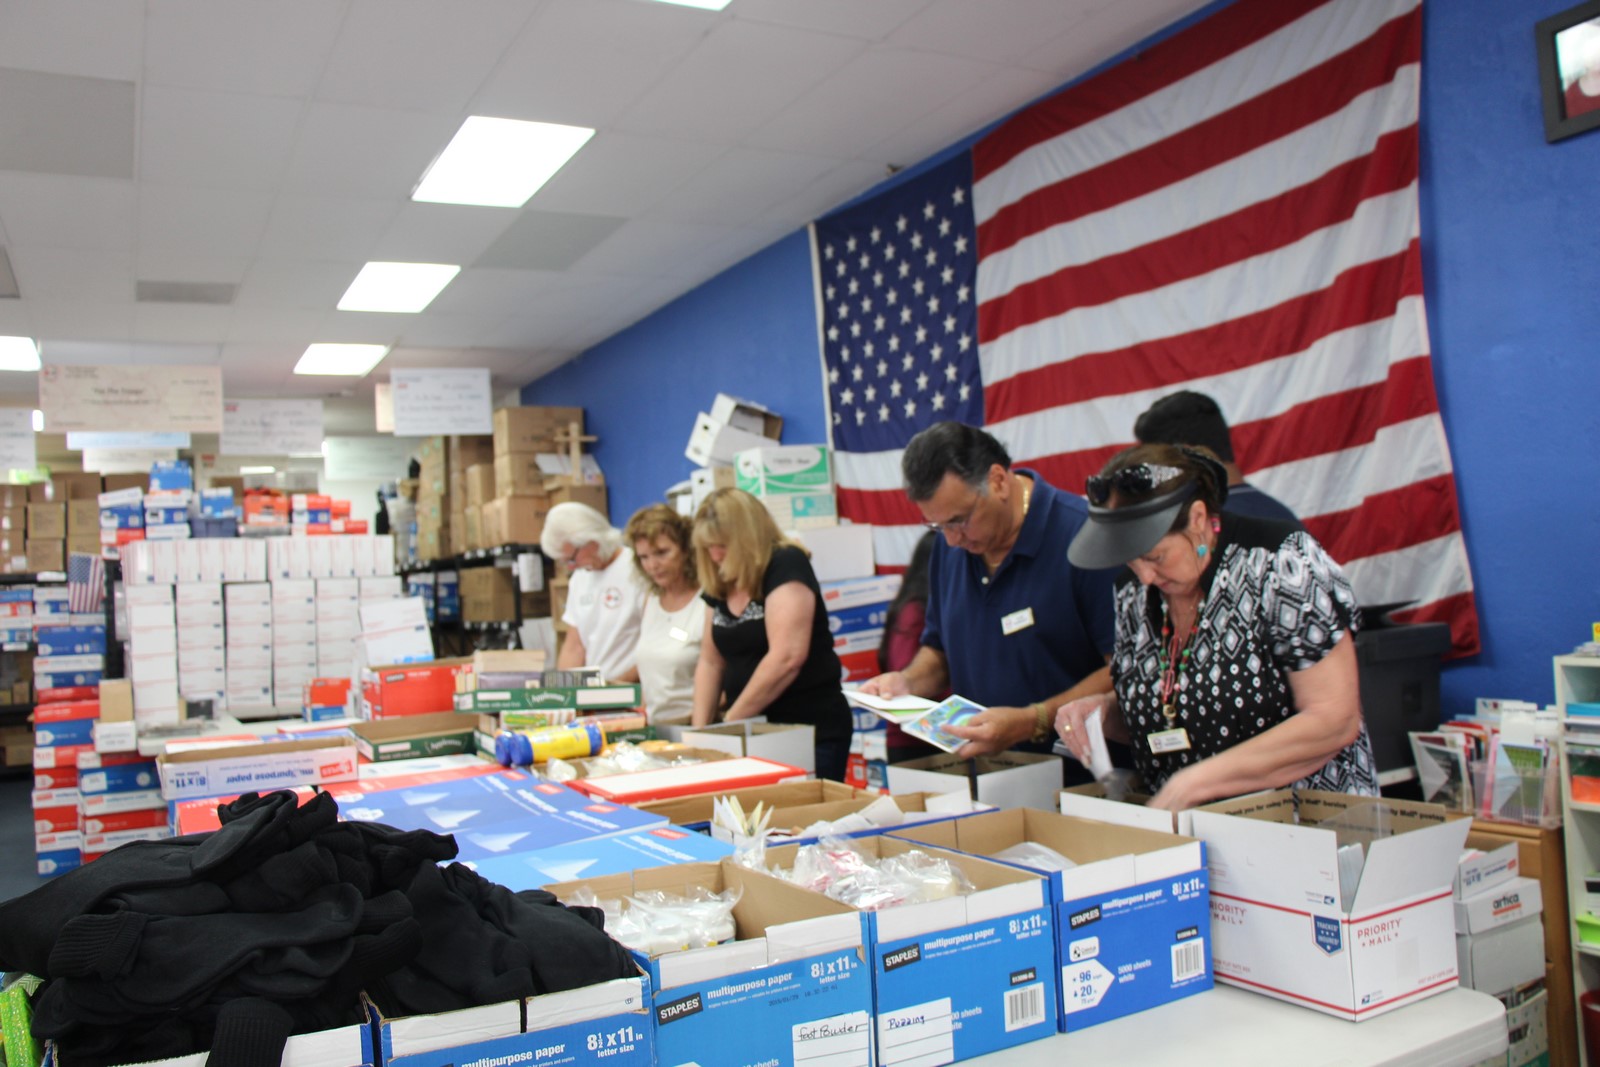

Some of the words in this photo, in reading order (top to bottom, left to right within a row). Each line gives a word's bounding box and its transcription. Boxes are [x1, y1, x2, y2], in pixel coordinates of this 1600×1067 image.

[175, 778, 186, 788] 11
[1190, 878, 1199, 892] 11
[1210, 900, 1246, 917] RIORITY
[1030, 914, 1040, 928] 11
[1071, 908, 1099, 926] STAPLES
[1357, 918, 1401, 940] PRIORITY
[924, 935, 973, 950] multipurpose
[975, 928, 995, 941] paper
[1369, 936, 1391, 947] MAIL
[836, 956, 851, 971] 11
[886, 948, 918, 966] STAPLES
[819, 974, 836, 985] letter
[837, 972, 851, 982] size
[1079, 970, 1091, 982] 96
[707, 979, 766, 1000] multipurpose
[768, 972, 793, 987] paper
[1080, 985, 1092, 997] 20
[660, 996, 700, 1020] STAPLES
[961, 1006, 982, 1018] sheets
[606, 1033, 617, 1047] x
[618, 1026, 633, 1043] 11
[535, 1043, 565, 1058] paper
[598, 1048, 618, 1058] letter
[620, 1044, 634, 1053] size
